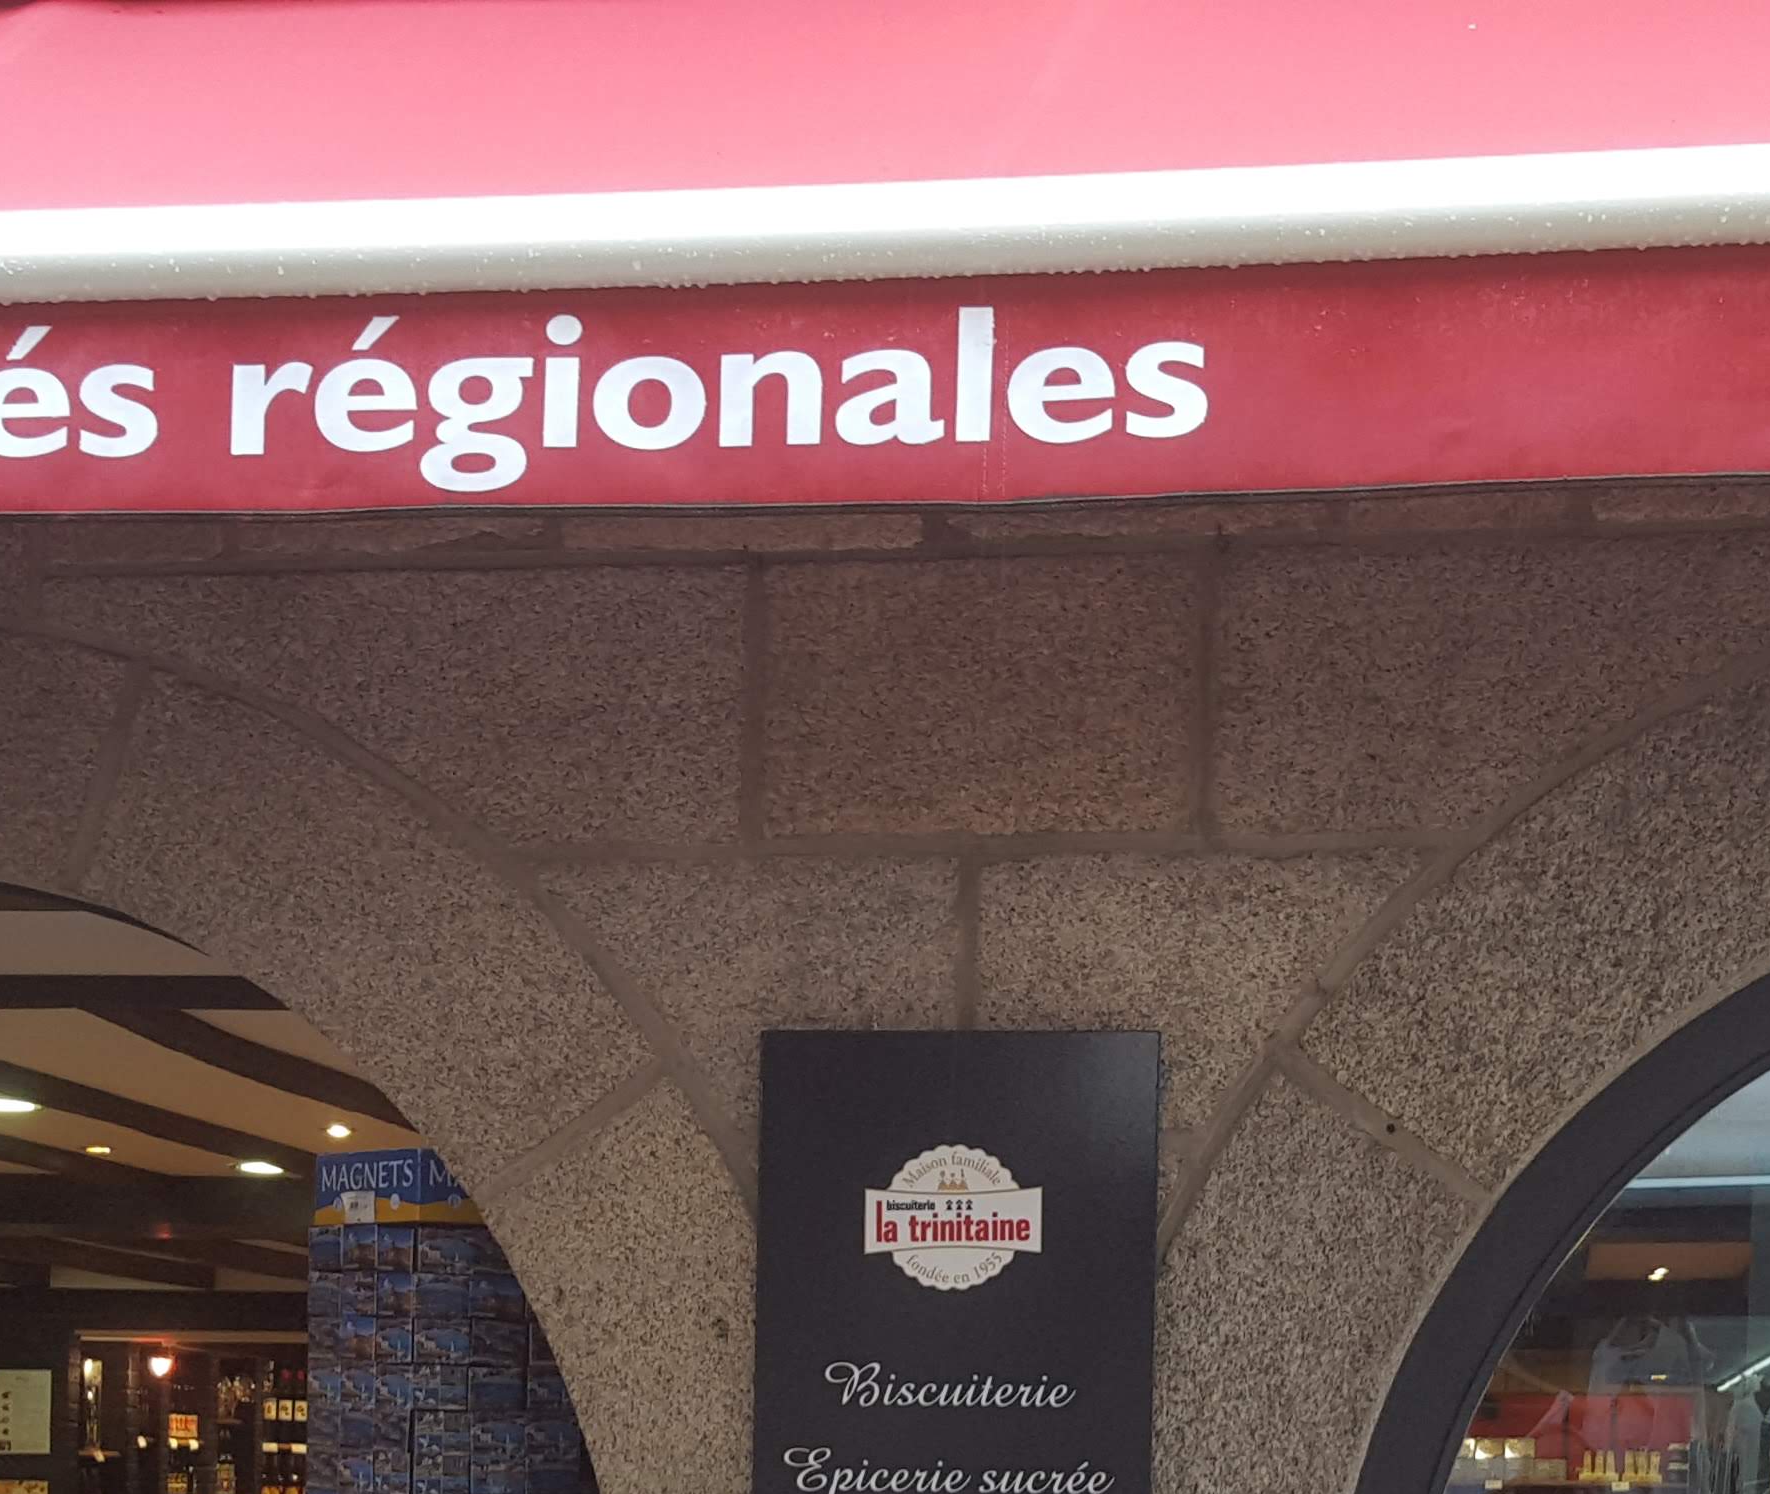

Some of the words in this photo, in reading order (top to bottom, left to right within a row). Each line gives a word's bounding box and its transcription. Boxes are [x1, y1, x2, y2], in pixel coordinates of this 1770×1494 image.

[229, 306, 1210, 494] régionales
[321, 1159, 413, 1191] MAGNETS
[902, 1156, 948, 1188] Maison
[951, 1152, 1001, 1187] familiale
[876, 1200, 898, 1243] la
[908, 1212, 1031, 1242] trinitaine
[886, 1199, 936, 1211] biscuiterie
[905, 1254, 950, 1284] fondée
[953, 1273, 971, 1284] en
[973, 1252, 1003, 1279] 1955
[823, 1360, 1077, 1409] Biscuiterie
